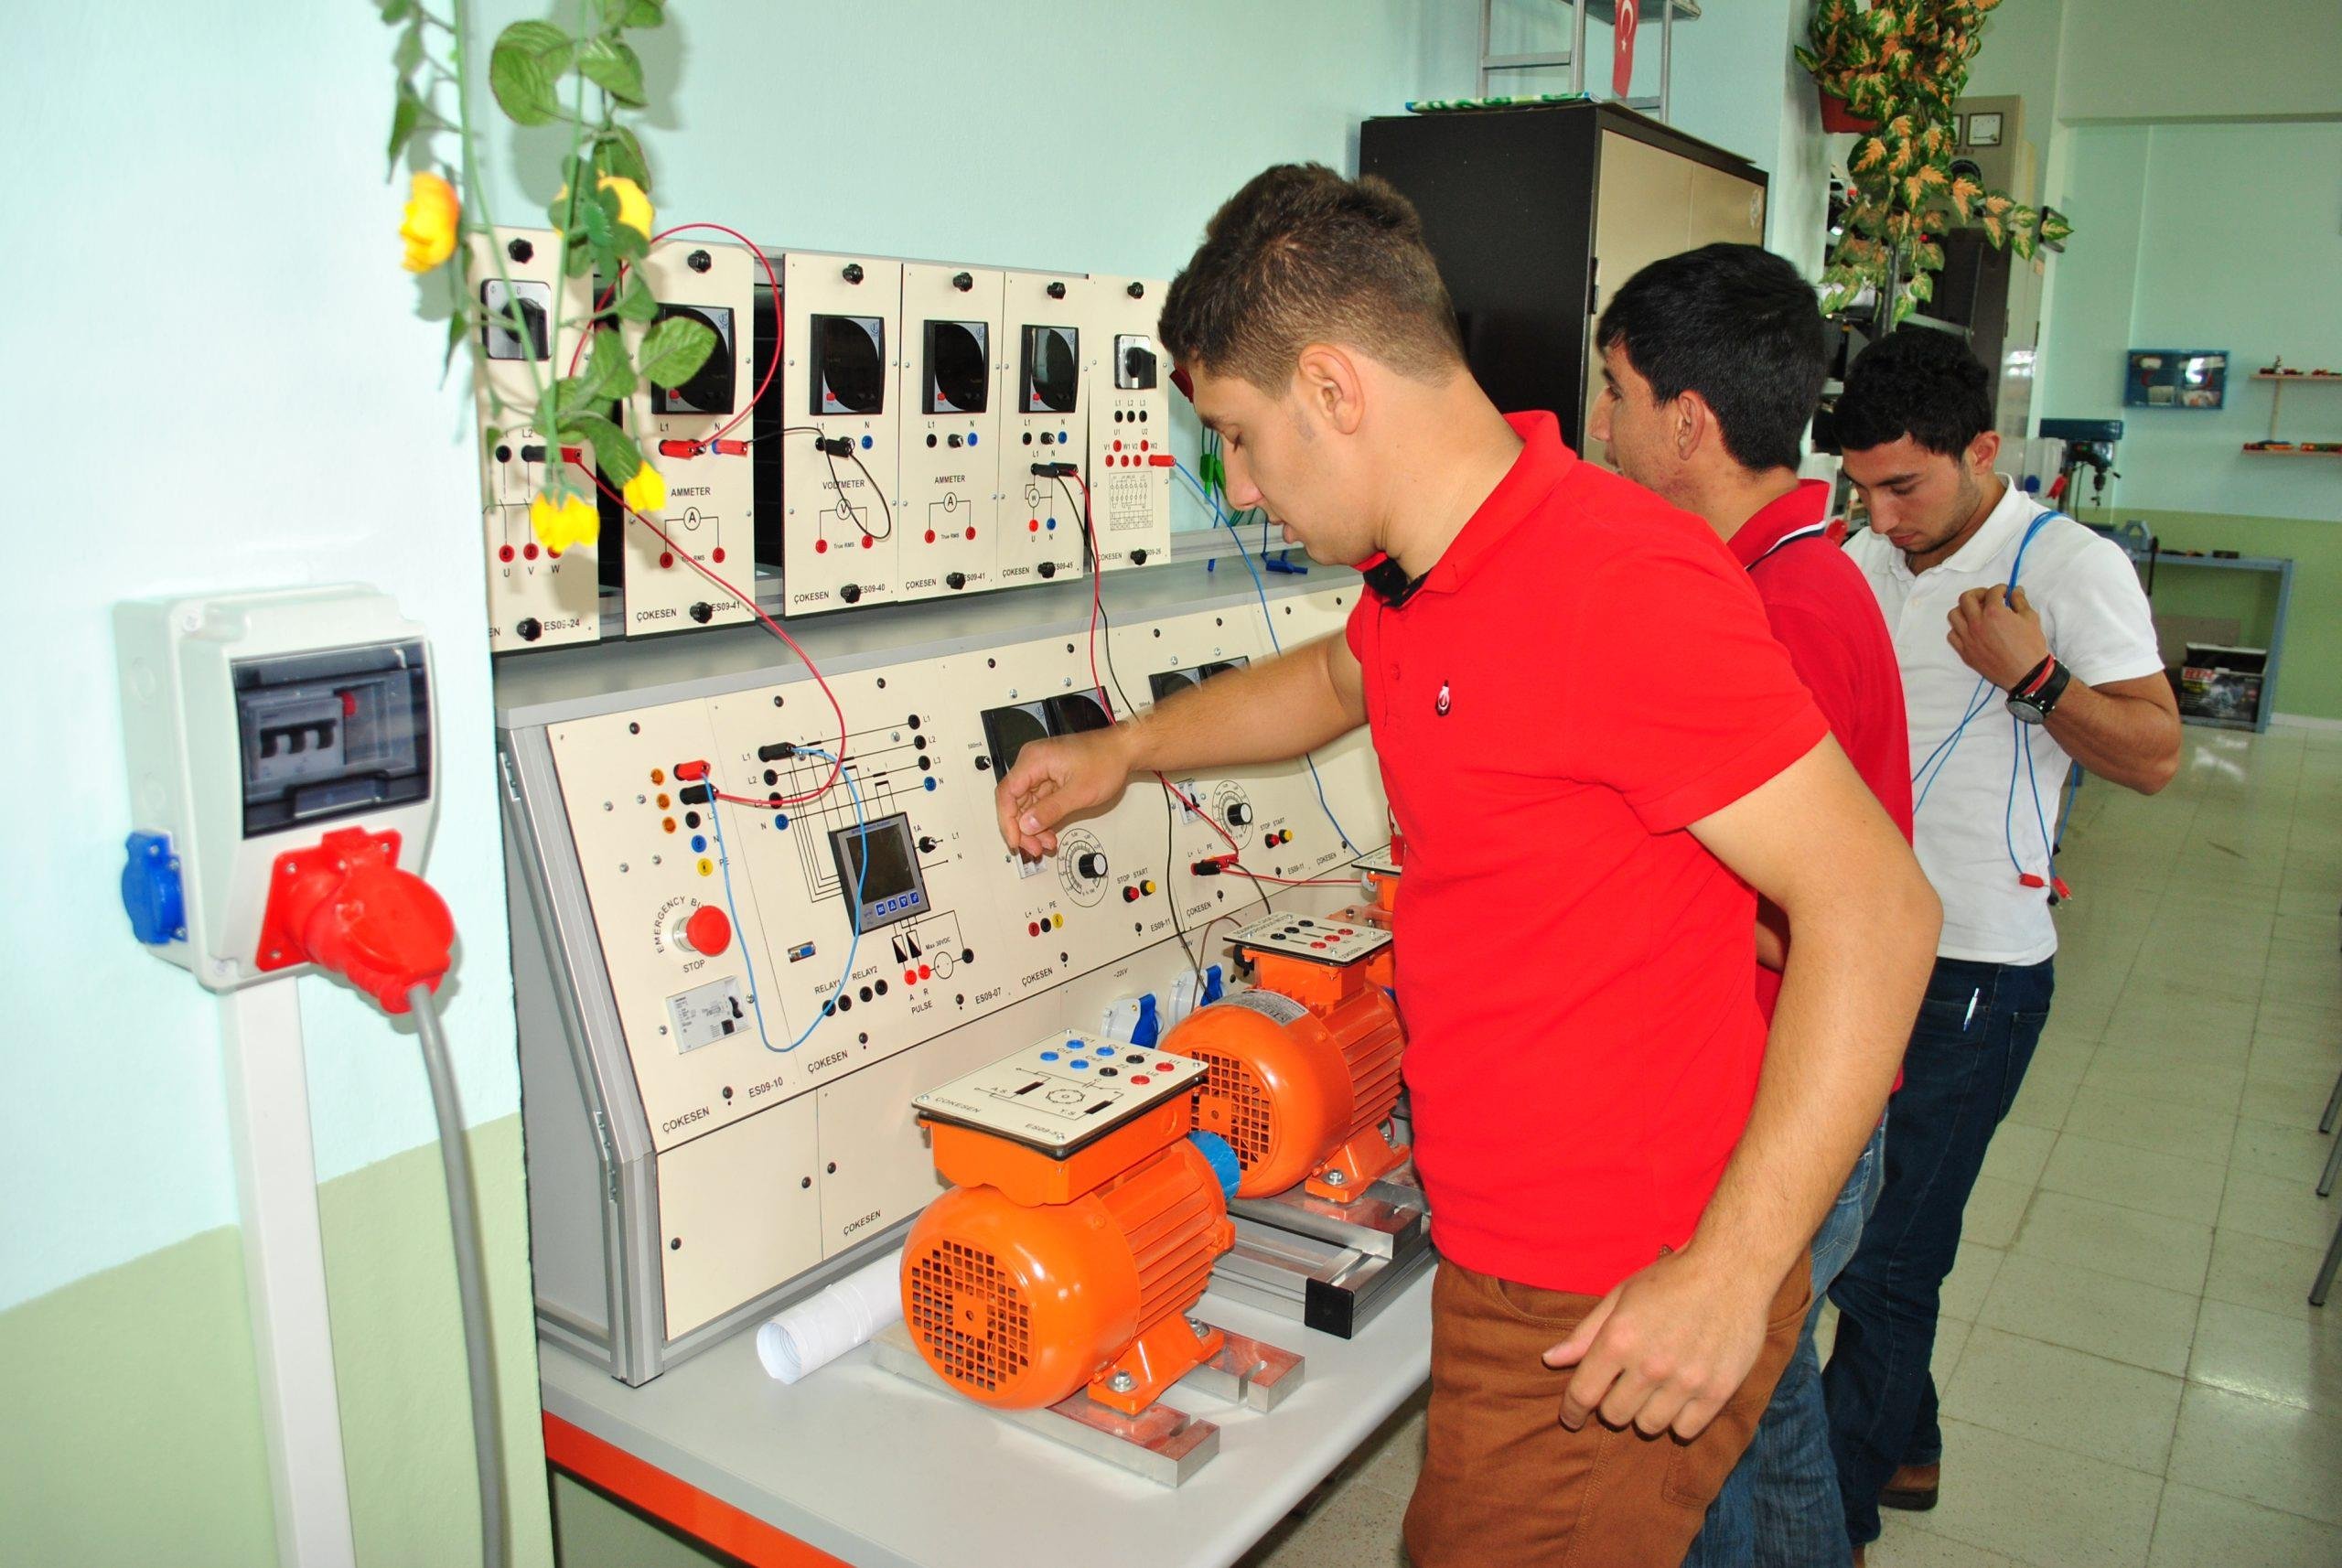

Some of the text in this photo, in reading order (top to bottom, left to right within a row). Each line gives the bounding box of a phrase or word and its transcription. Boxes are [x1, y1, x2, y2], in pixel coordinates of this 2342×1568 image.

[660, 423, 669, 432] L1
[714, 423, 721, 432] N
[928, 421, 935, 429] L1
[521, 429, 533, 438] L2
[822, 479, 865, 489] VOLTMETER
[934, 475, 966, 484] AMMETER
[671, 487, 711, 497] AMMETER
[948, 496, 954, 506] A
[688, 511, 696, 522] A
[503, 568, 510, 577] U
[528, 566, 534, 575] V
[551, 564, 560, 575] W
[1002, 567, 1030, 578] ÇOKESEN
[905, 578, 937, 590] ÇOKESEN
[793, 591, 830, 604] ÇOKESEN
[636, 608, 677, 623] ÇOKESEN
[923, 714, 930, 723] L1
[929, 736, 936, 744] L2
[742, 753, 751, 761] L1
[933, 757, 941, 765] L3
[747, 776, 757, 785] L2
[939, 777, 944, 785] N
[760, 822, 768, 831] N
[951, 832, 960, 840] L1
[957, 853, 962, 861] N
[1116, 867, 1149, 885] STOP START
[1048, 900, 1058, 909] PE
[654, 896, 685, 953] EMERGENCY
[1150, 918, 1171, 933] ES09-11
[925, 942, 936, 950] Max
[682, 959, 705, 973] STOP
[852, 965, 878, 982] RELAY2
[1021, 966, 1053, 987] ÇOKESEN
[814, 979, 842, 994] RELAY1
[909, 993, 915, 1002] A
[974, 986, 1002, 1004] ES09-07
[910, 1000, 933, 1015] PULSE
[807, 1049, 848, 1074] ÇOKESEN
[748, 1076, 784, 1099] ES09-10
[661, 1105, 711, 1134] ÇOKESEN
[843, 1208, 881, 1236] ÇOKESEN
